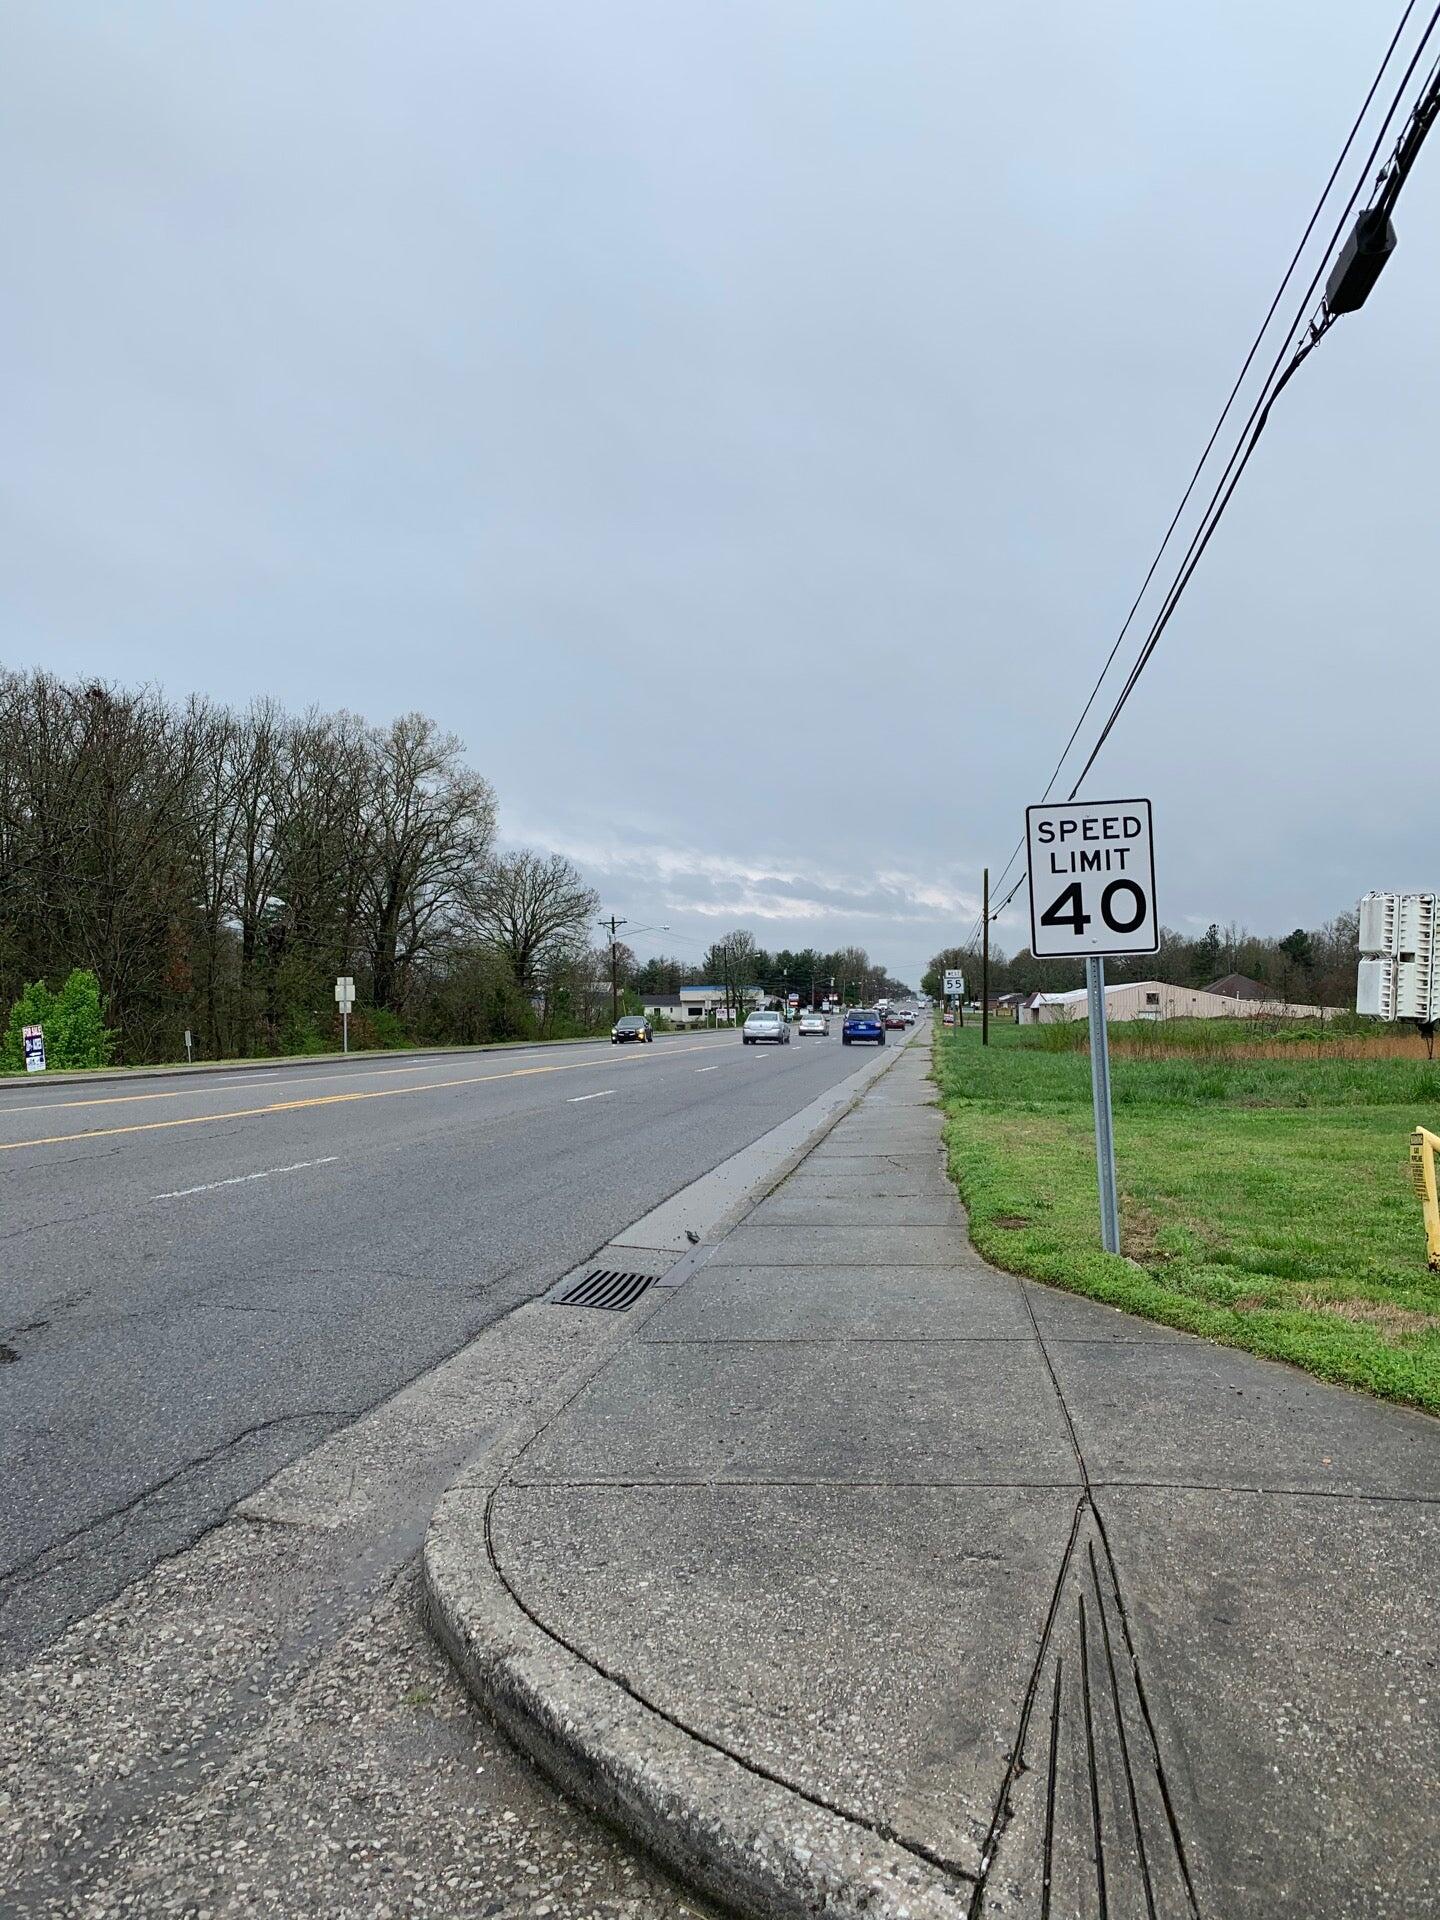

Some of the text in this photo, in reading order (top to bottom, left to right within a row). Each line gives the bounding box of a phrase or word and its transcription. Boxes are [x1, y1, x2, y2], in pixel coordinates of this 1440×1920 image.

[1038, 817, 1141, 843] SPEED
[1050, 848, 1131, 874] LIMIT
[1040, 878, 1147, 935] 40
[947, 980, 961, 989] 55
